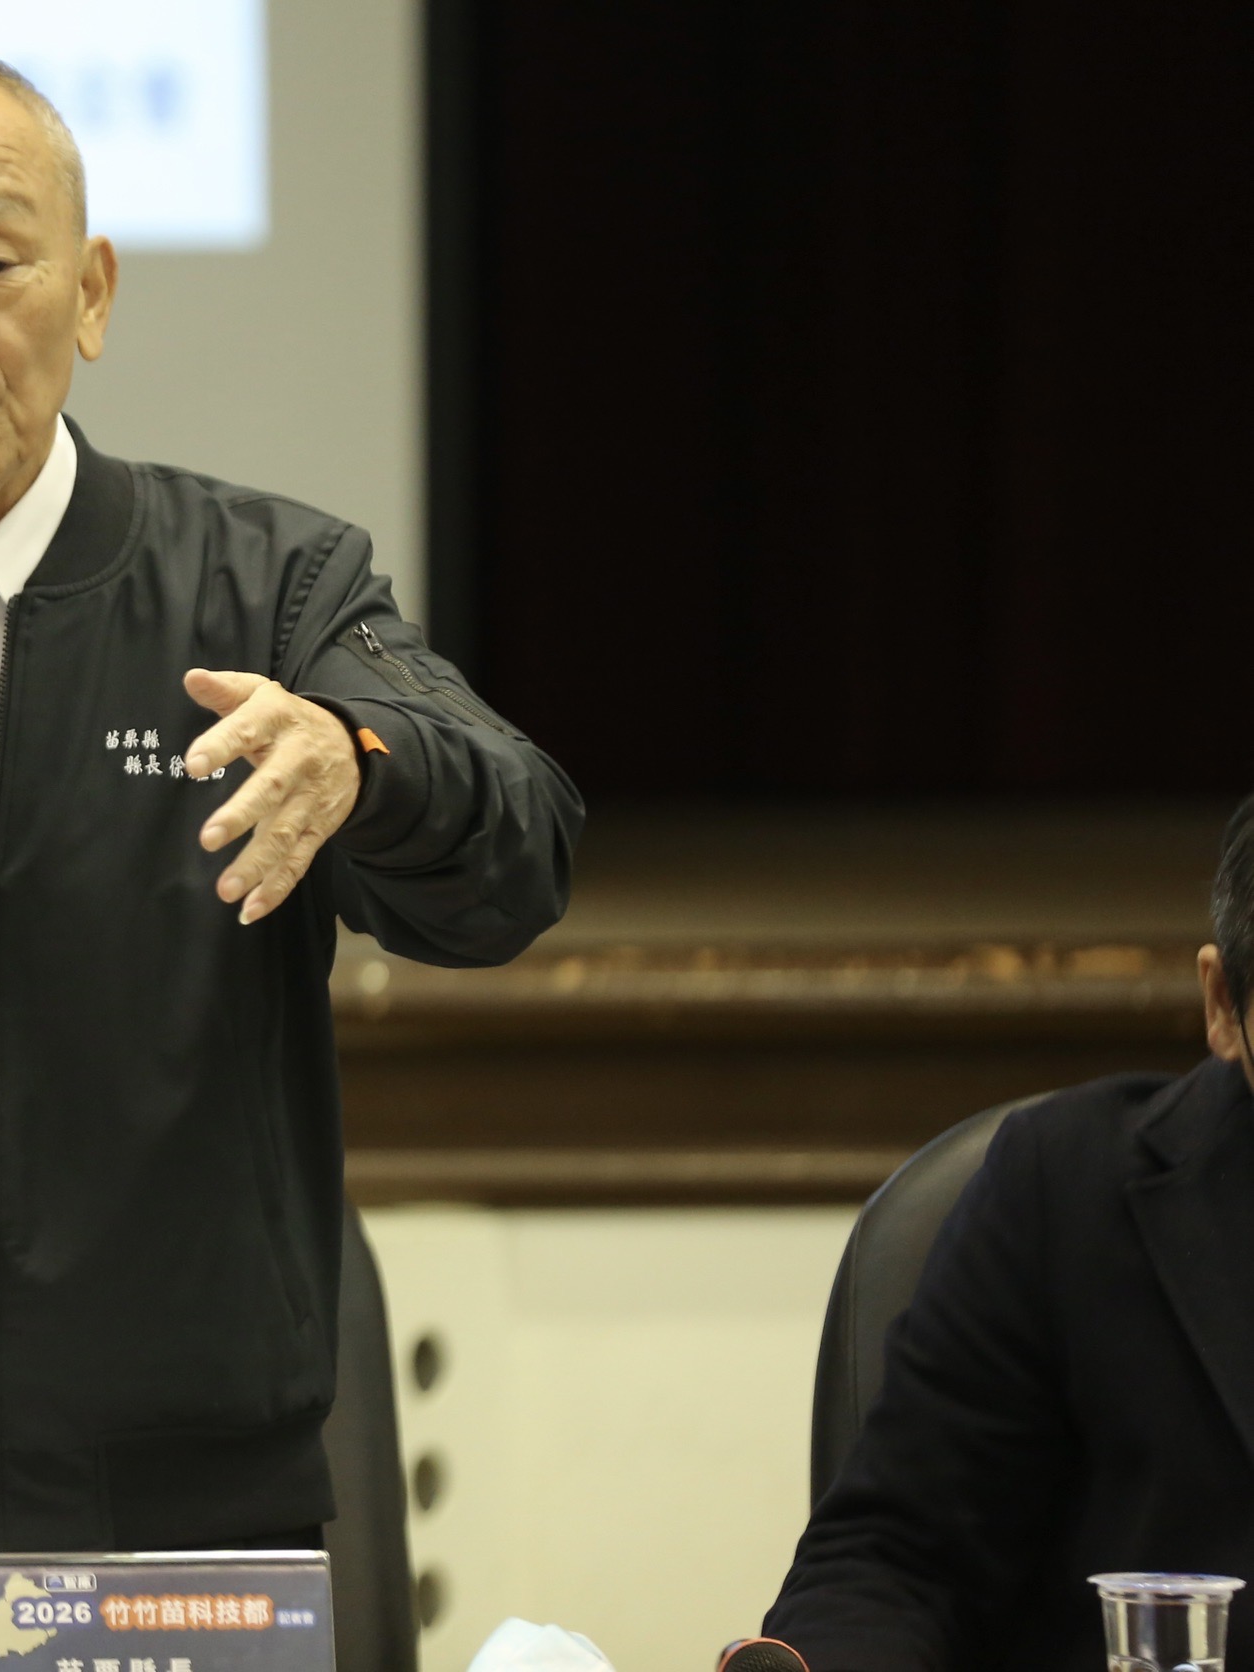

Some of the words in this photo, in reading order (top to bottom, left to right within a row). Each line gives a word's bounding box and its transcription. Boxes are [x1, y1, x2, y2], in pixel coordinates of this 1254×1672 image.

[106, 729, 160, 749] 苗栗縣
[18, 1601, 92, 1625] 2026
[104, 1599, 269, 1627] 竹竹苗科技都
